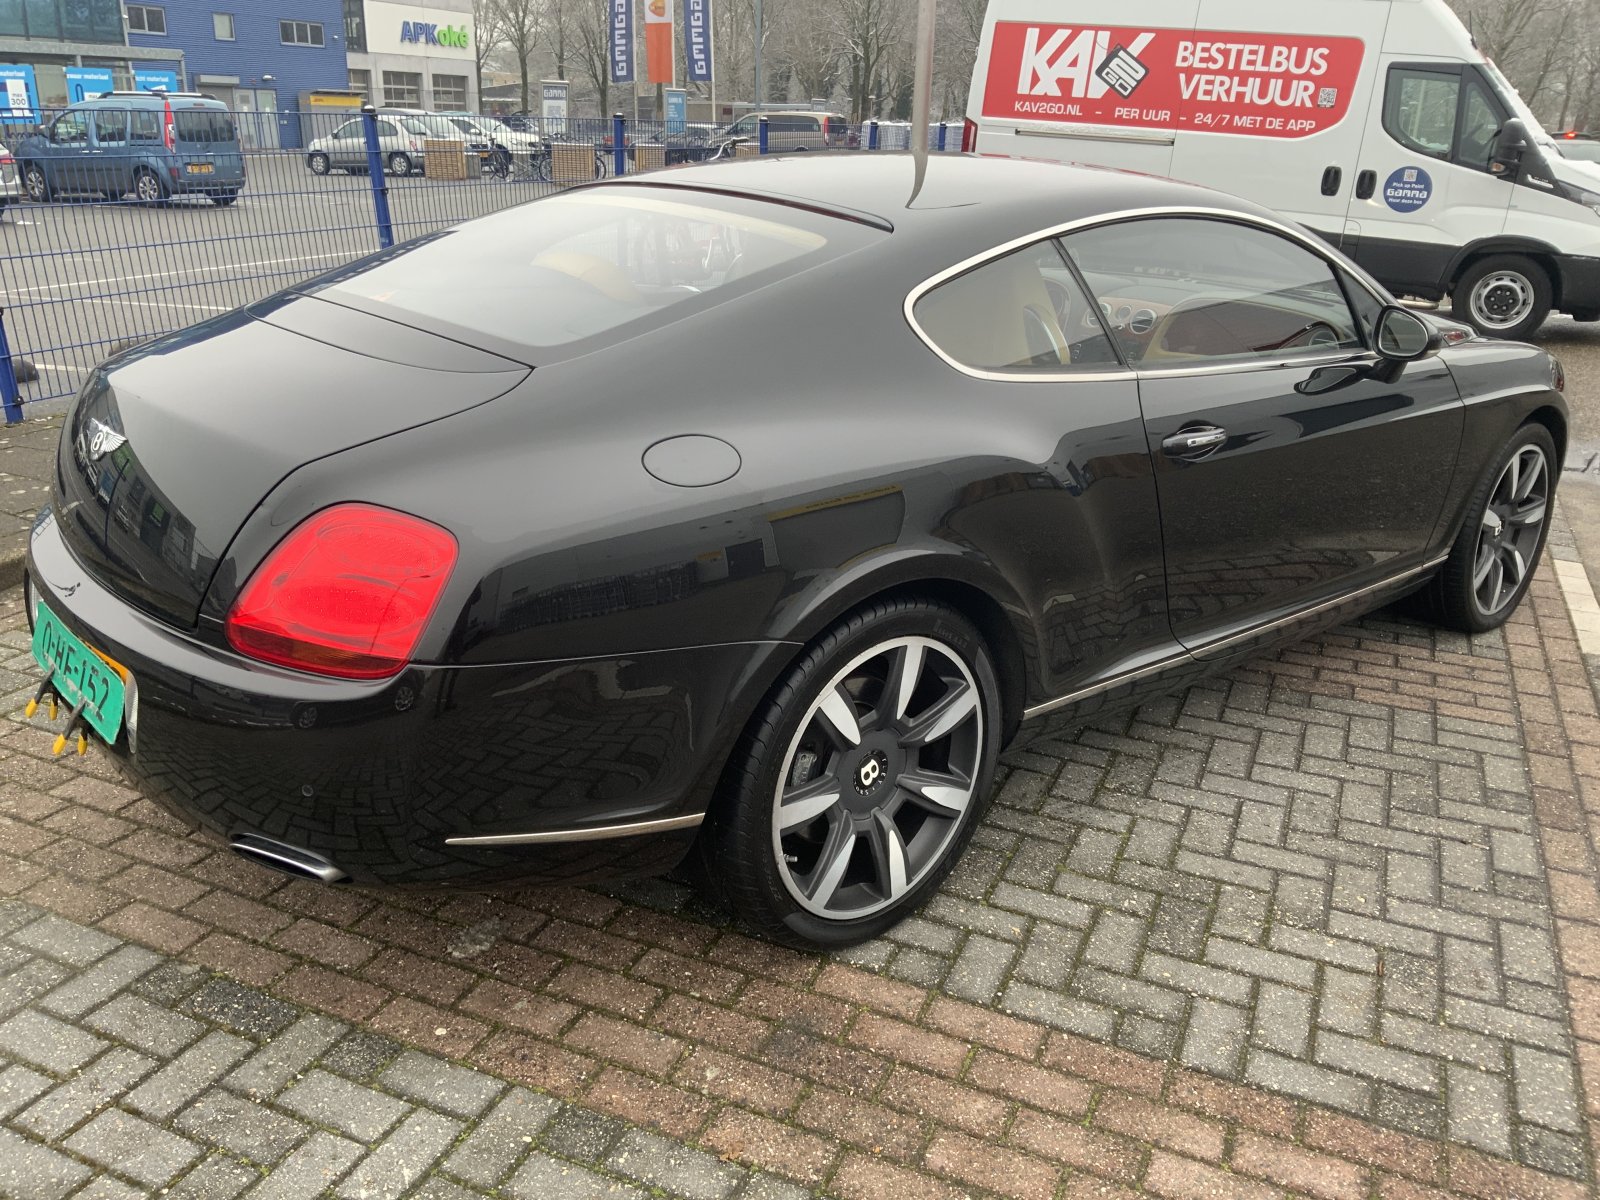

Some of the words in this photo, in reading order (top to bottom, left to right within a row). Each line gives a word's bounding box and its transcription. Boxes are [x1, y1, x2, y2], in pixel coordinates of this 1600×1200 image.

[1017, 27, 1156, 99] KAV
[1175, 40, 1330, 76] BESTELBUS
[11, 98, 26, 106] 300
[1178, 73, 1316, 108] VERHUUR
[1014, 101, 1083, 116] KAV2GO.NL
[1114, 107, 1140, 120] PER
[1142, 109, 1171, 122] UUR
[1194, 112, 1231, 128] 24/7
[1233, 115, 1263, 128] MET
[1265, 117, 1285, 130] DE
[1286, 119, 1316, 132] APP
